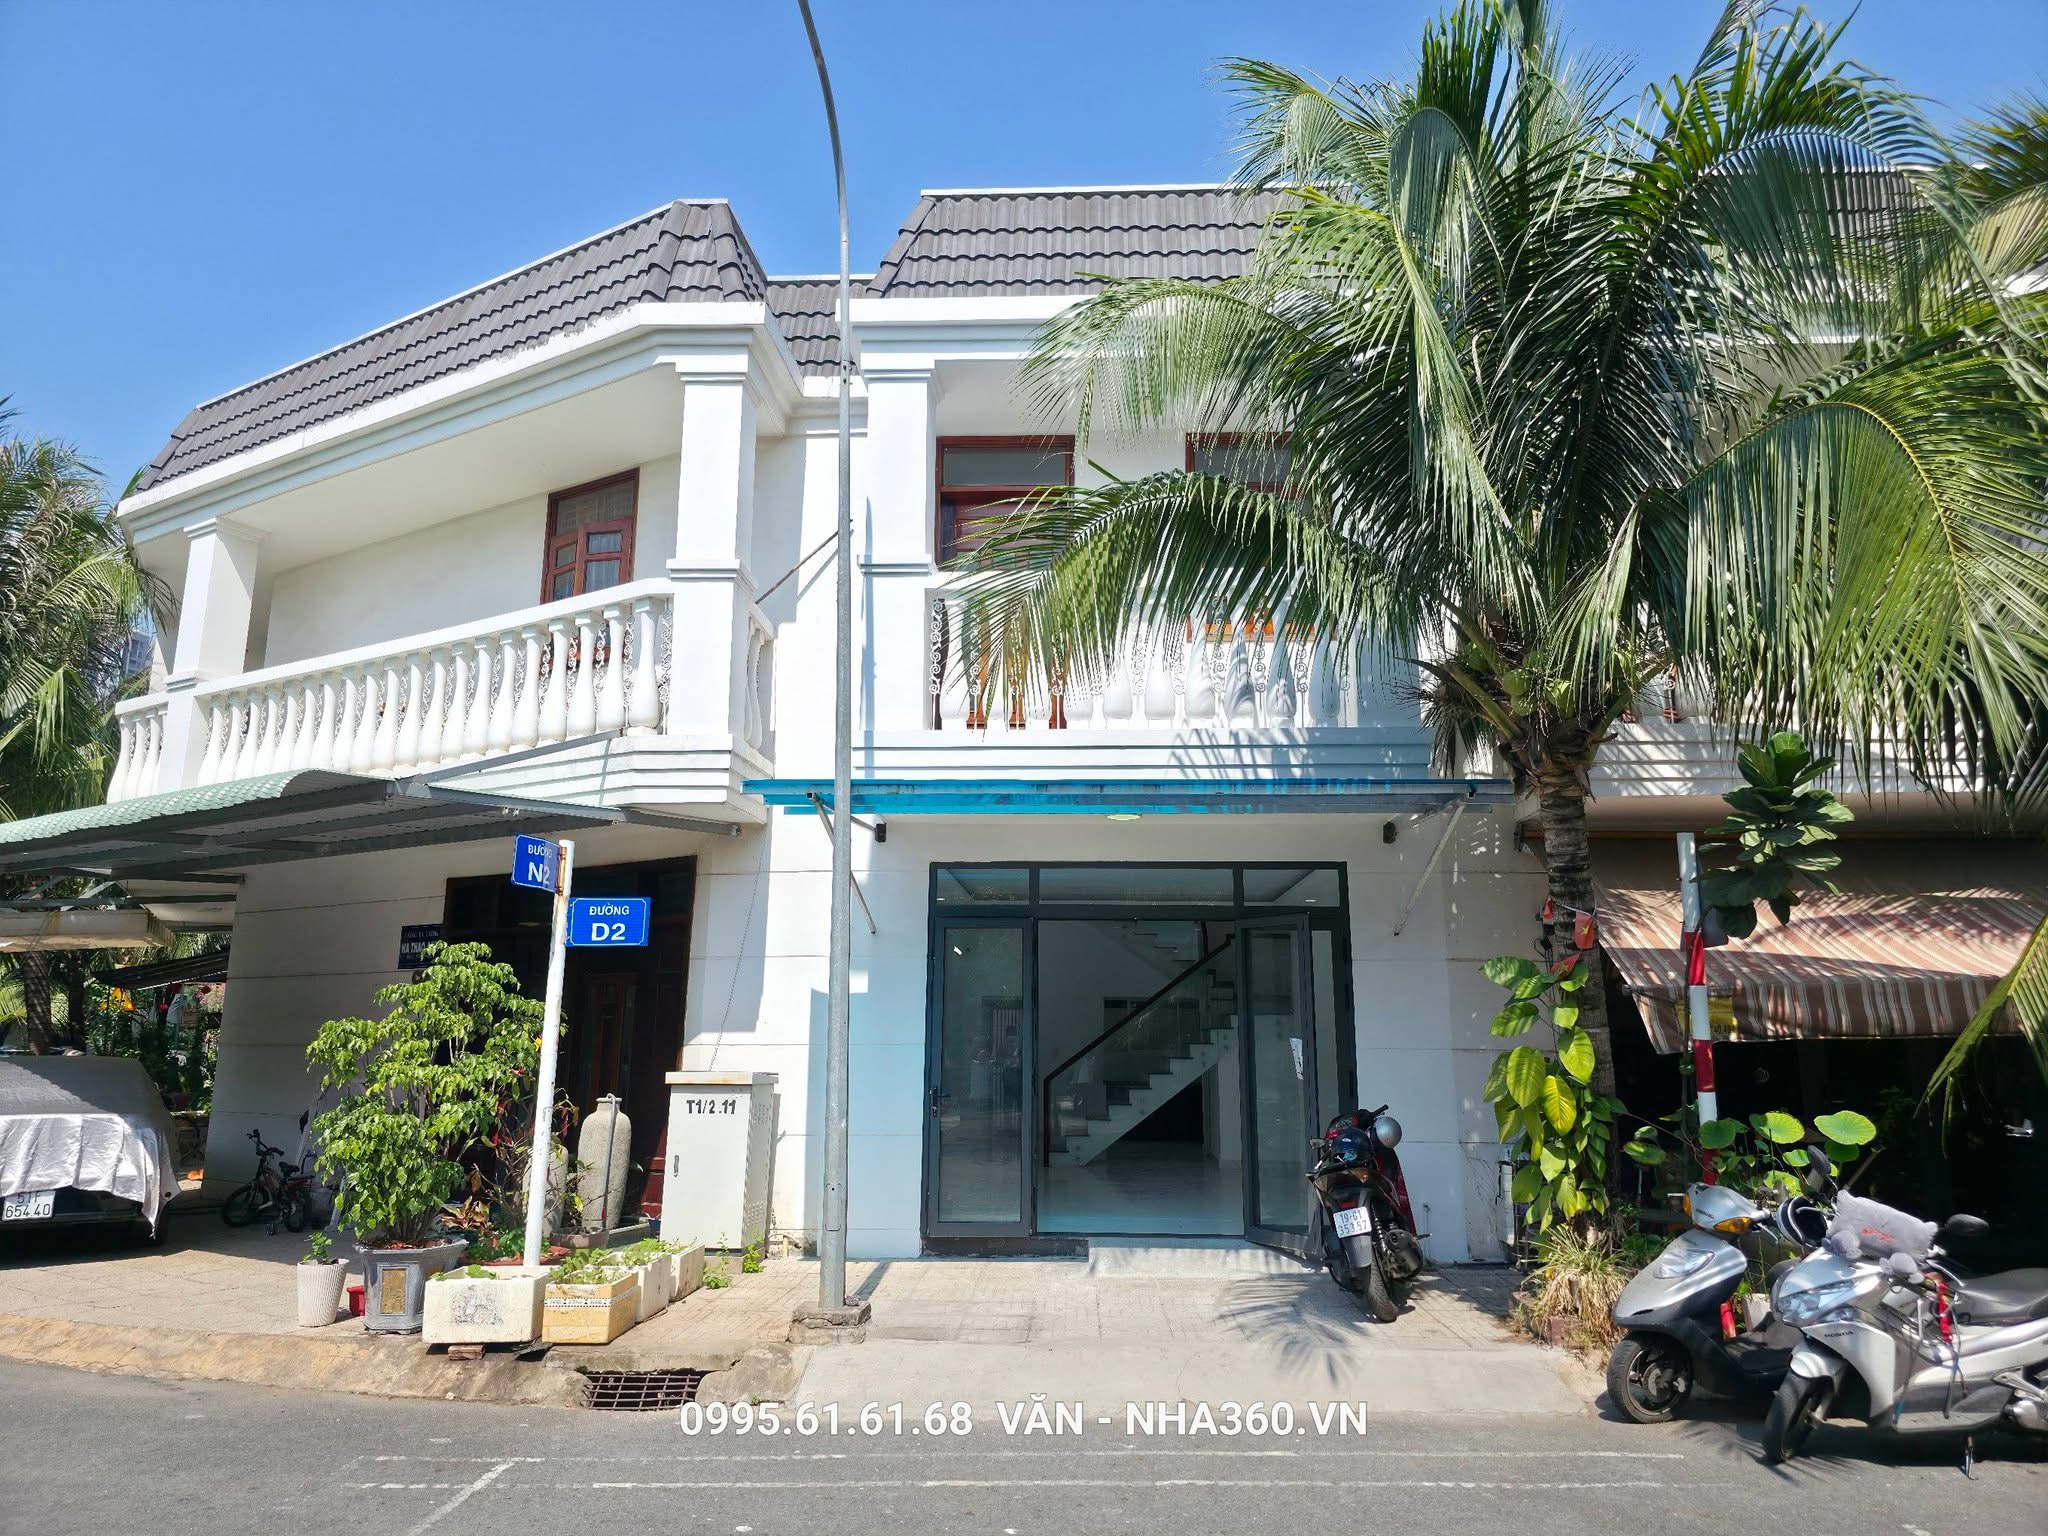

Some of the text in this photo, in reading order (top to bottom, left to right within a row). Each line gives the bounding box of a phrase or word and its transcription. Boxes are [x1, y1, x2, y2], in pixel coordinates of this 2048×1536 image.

[527, 862, 551, 885] N2
[589, 902, 630, 916] ĐƯỜNG
[591, 922, 627, 941] D2
[6, 1204, 51, 1218] 654.40
[1340, 1210, 1362, 1223] 19-G1
[1338, 1220, 1366, 1235] 353.57
